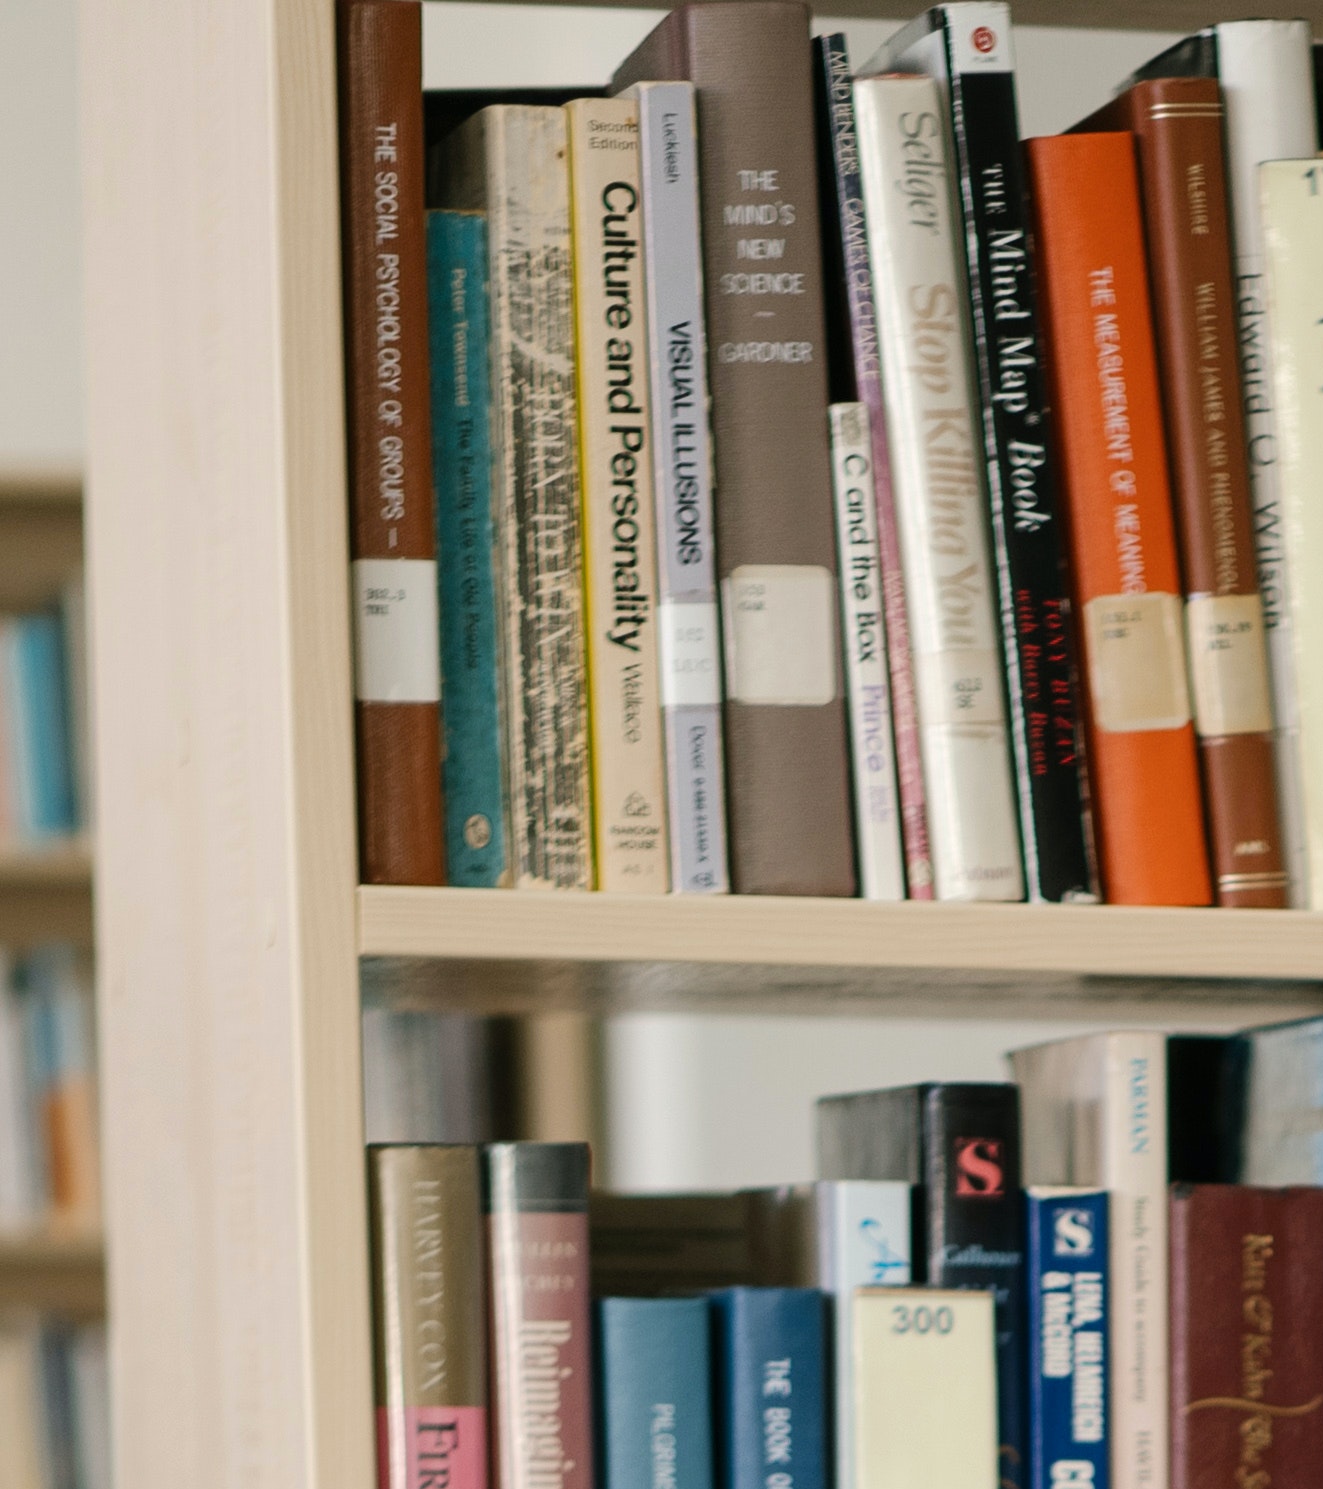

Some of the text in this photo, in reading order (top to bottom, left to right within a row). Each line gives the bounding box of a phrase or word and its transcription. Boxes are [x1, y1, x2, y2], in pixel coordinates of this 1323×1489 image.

[590, 137, 638, 152] Edition
[828, 51, 859, 176] MIND BENDERS
[724, 201, 796, 226] MIND'S
[737, 170, 780, 191] THE
[895, 111, 945, 237] Seliger
[981, 163, 1006, 215] THE
[720, 273, 806, 296] SCIENCE
[736, 239, 787, 260] NEW
[988, 227, 1034, 322] Mind
[1087, 267, 1115, 306] THE
[374, 122, 404, 521] THE SOCIAL PSYCHOLOGY OF GROUPS
[450, 268, 471, 406] Peter Townsend
[718, 341, 814, 364] GARDNER
[1094, 313, 1133, 464] MEASUREMENT
[1193, 282, 1230, 467] WILLIAM JAMES AND
[600, 180, 651, 652] Culture and Personality
[667, 320, 701, 566] VISUAL ILLUSIONS
[904, 283, 981, 557] Stop Killing
[1235, 272, 1285, 630] Edward Wilson
[845, 488, 875, 545] and
[1006, 438, 1051, 532] Book
[1109, 469, 1137, 496] OF
[850, 555, 881, 599] the
[1114, 504, 1147, 595] MEANING
[853, 610, 886, 664] Box
[620, 662, 644, 744] Wallace
[861, 684, 890, 773] Prince
[411, 1179, 448, 1392] HARVEY COX
[891, 1306, 954, 1336] 300
[761, 1358, 791, 1398] THE
[764, 1407, 793, 1464] BOOK
